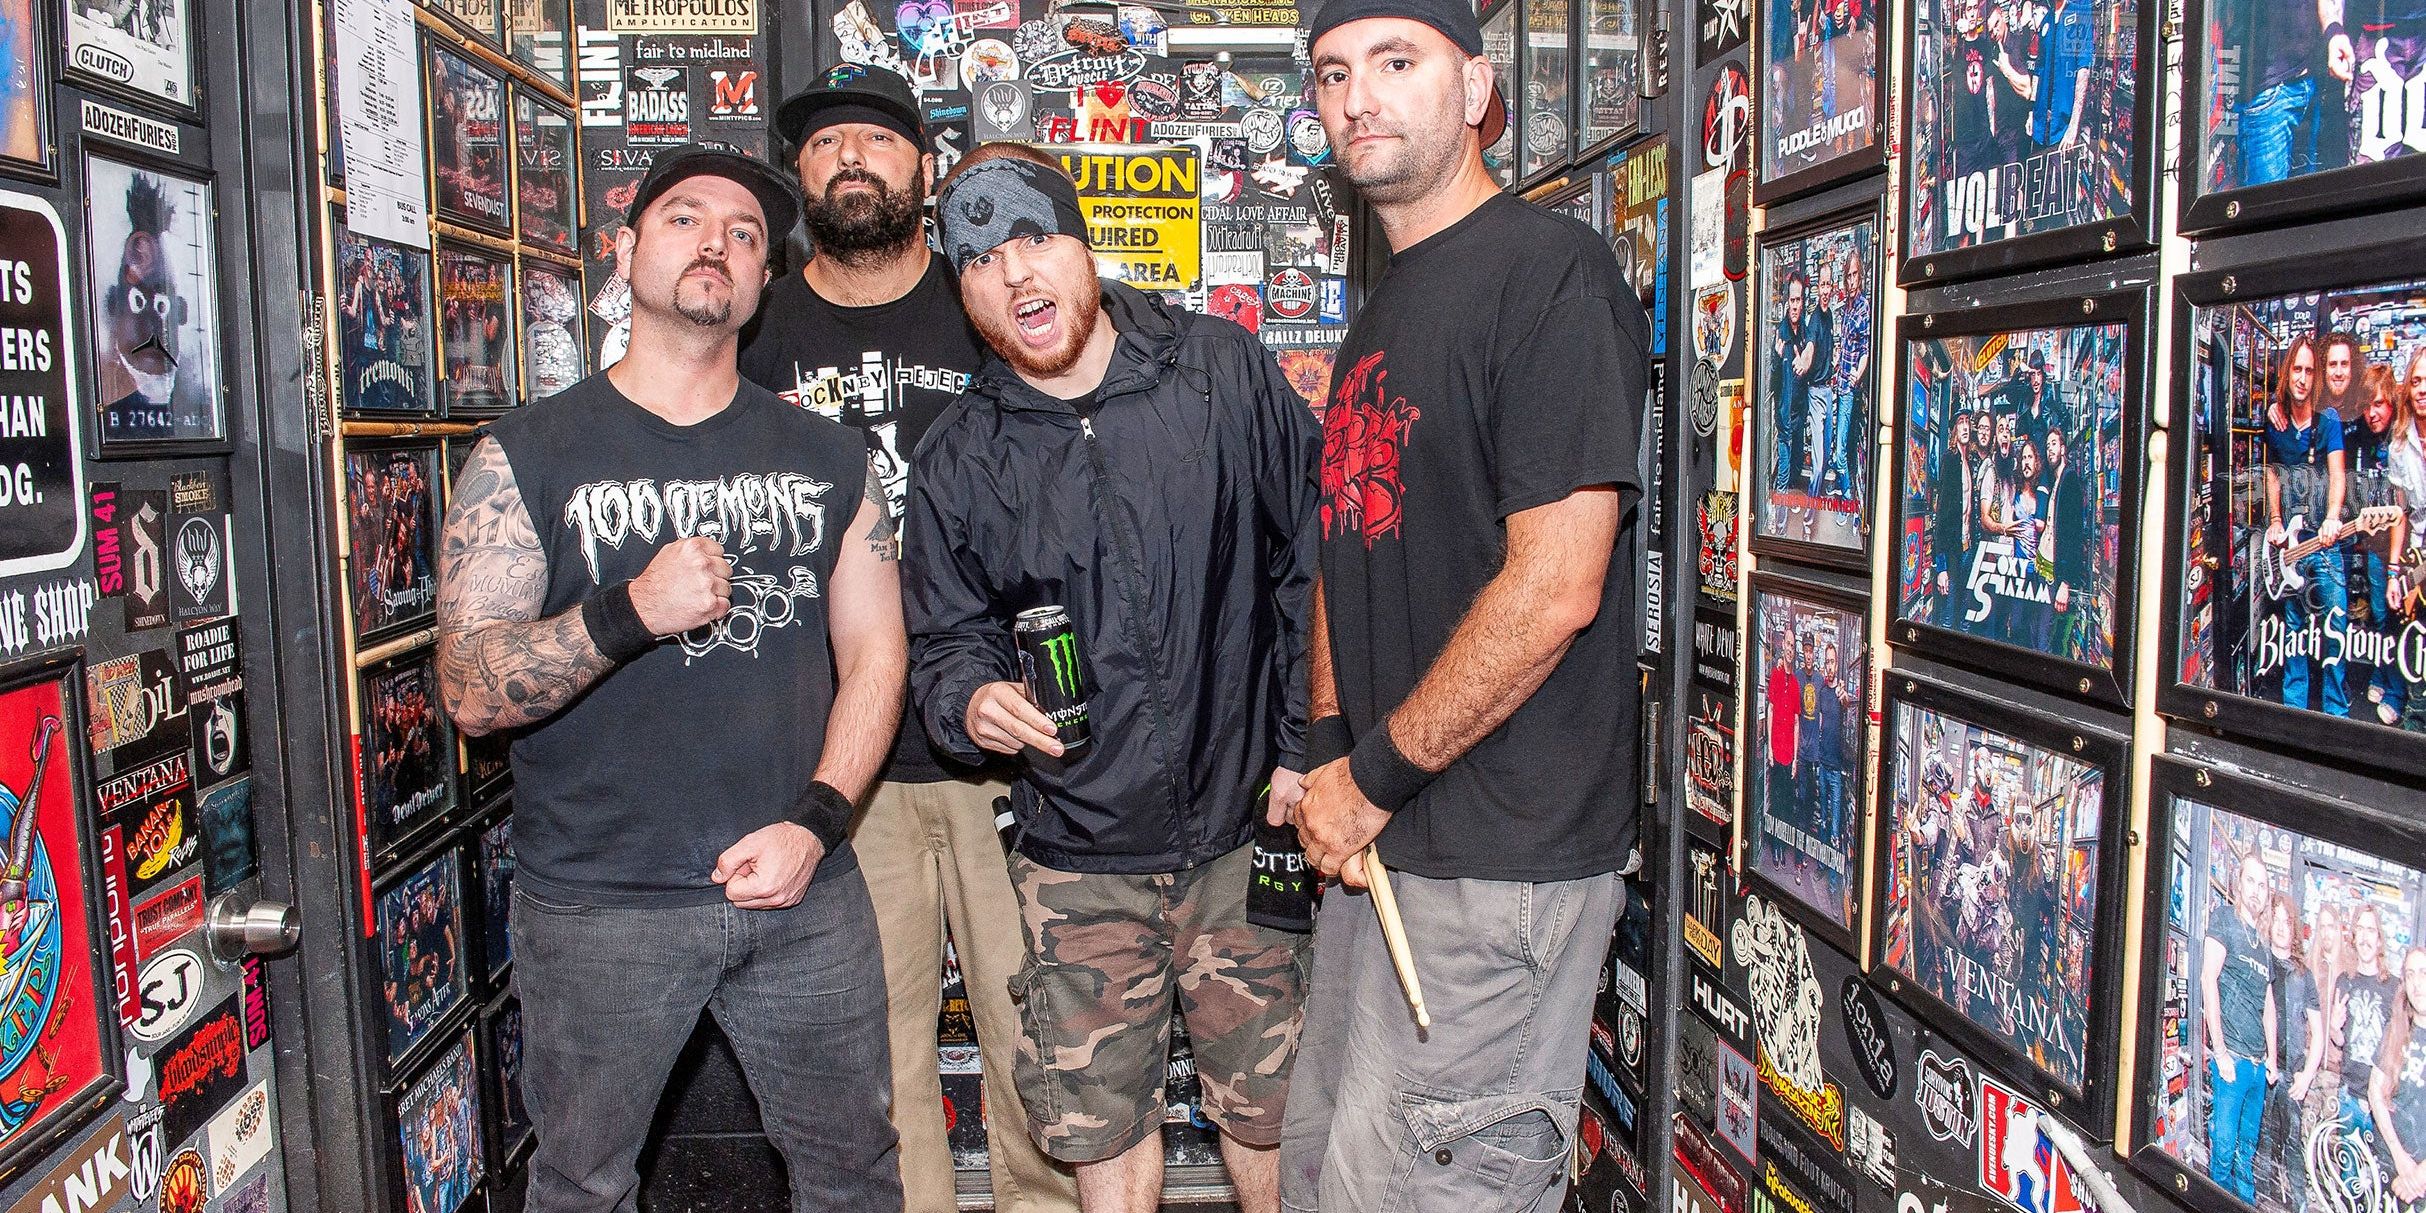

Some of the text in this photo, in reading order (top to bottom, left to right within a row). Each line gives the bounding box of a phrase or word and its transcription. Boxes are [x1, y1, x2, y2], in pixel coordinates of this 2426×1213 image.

[614, 0, 749, 17] METROPOULOS
[1252, 9, 1300, 24] HEADS
[80, 48, 129, 80] CLUTCH
[636, 39, 751, 59] fair to midland
[578, 25, 623, 127] FLINT
[1041, 54, 1129, 87] Detroit
[1067, 71, 1108, 86] MUSCLE
[629, 92, 688, 121] BADASS
[711, 71, 758, 114] M
[930, 105, 968, 120] Shinedown
[1050, 117, 1148, 142] FLINT
[1153, 123, 1233, 137] ADOZENFURIES
[1777, 105, 1866, 159] PUDDLE MUDD
[1061, 155, 1196, 193] UTION
[1946, 143, 2088, 238] VOLBEAT
[405, 202, 417, 214] CALL
[464, 189, 505, 218] SEVENDUST
[1092, 206, 1193, 220] PROTECTION
[1235, 206, 1265, 221] LOVE
[1267, 206, 1308, 221] AFFAIR
[1118, 262, 1181, 283] AREA
[1271, 286, 1312, 301] MACHINE
[1, 327, 51, 373] ERS
[1265, 331, 1304, 345] BALLZ
[1976, 332, 2010, 371] CLUTCH
[360, 358, 415, 397] tremonti
[110, 411, 120, 427] B
[1650, 362, 1665, 537] fair to midland
[175, 489, 210, 504] SMOKE
[93, 491, 124, 594] SUM 41
[564, 471, 834, 586] 100 DEMONS
[1965, 540, 2029, 590] FOXY
[33, 577, 95, 648] SHOP
[178, 602, 223, 618] HALCYON WAY
[382, 587, 418, 616] Saving
[1646, 555, 1662, 650] SEROSIA
[1964, 572, 2051, 624] SHAZAM
[186, 624, 231, 652] ROADIE
[2256, 612, 2321, 677] Black
[2321, 605, 2396, 669] Stone
[184, 641, 236, 674] FOR LIFE
[189, 676, 244, 706] mushroomhead
[98, 757, 191, 814] VENTANA
[391, 781, 445, 825] DevilDriver
[1258, 874, 1302, 892] RGY
[137, 903, 163, 927] TRUST
[1701, 931, 1721, 960] DAY
[140, 960, 192, 1027] SJ
[1756, 973, 1770, 1003] THE
[1946, 944, 2068, 1053] VENTANA
[245, 986, 267, 1048] SUM
[1692, 974, 1749, 1041] HURT
[1786, 1014, 1802, 1062] SHOP
[1846, 982, 1894, 1089] ionia
[414, 1057, 449, 1102] MICHAELS
[447, 1042, 464, 1068] BAND
[1924, 1066, 1954, 1100] SURVIVING
[1919, 1084, 1972, 1142] JUSTIN
[1988, 1092, 1998, 1186] AVENUESKY.COM
[177, 1150, 201, 1169] DEATH
[1799, 1157, 1820, 1184] FOOT
